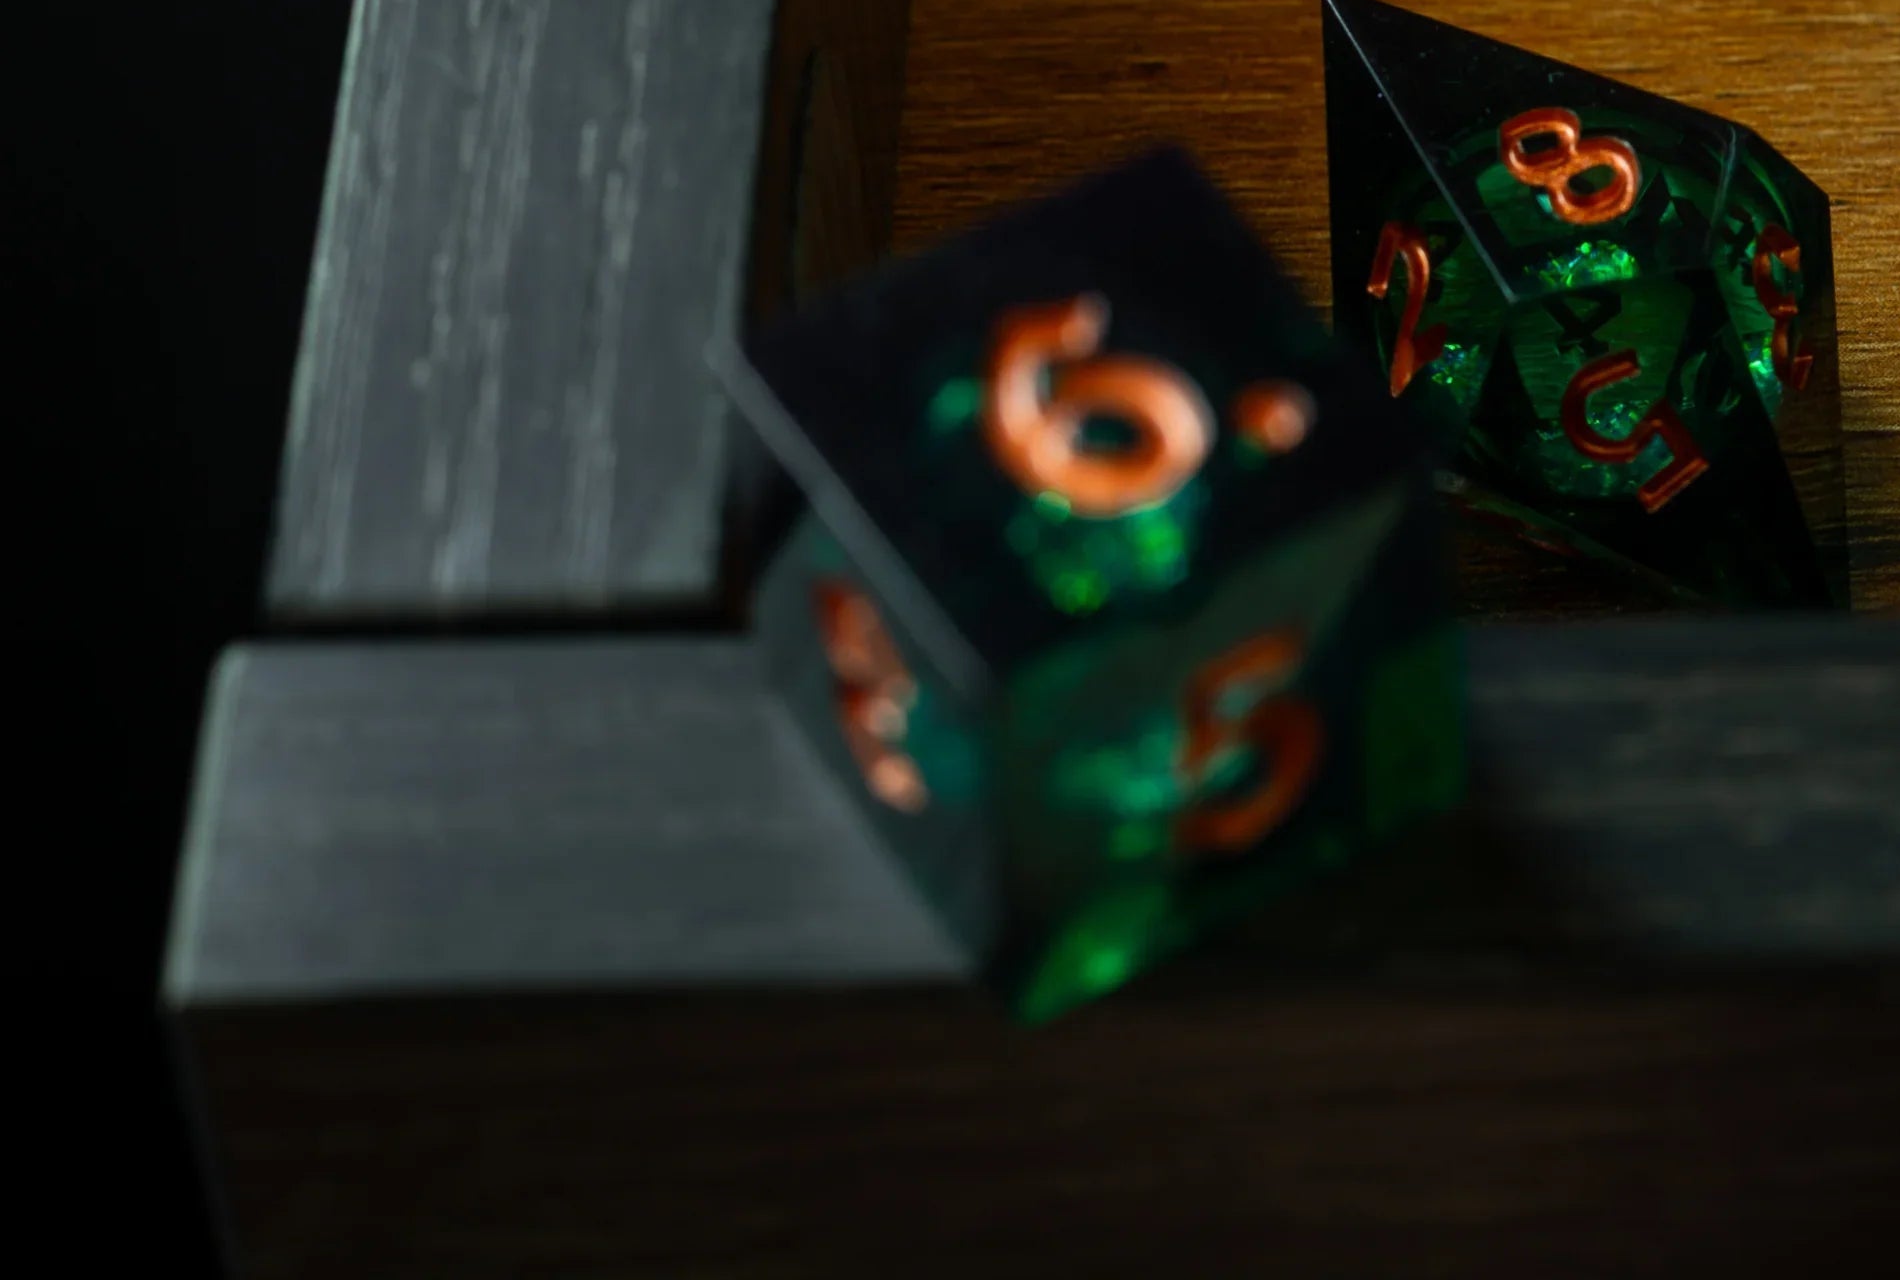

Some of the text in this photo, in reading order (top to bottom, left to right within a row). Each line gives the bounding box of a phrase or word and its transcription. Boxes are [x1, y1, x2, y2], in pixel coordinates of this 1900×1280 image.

[1500, 105, 1640, 223] 8
[1367, 220, 1449, 399] 2
[1561, 347, 1711, 517] 5
[1162, 623, 1327, 862] 5
